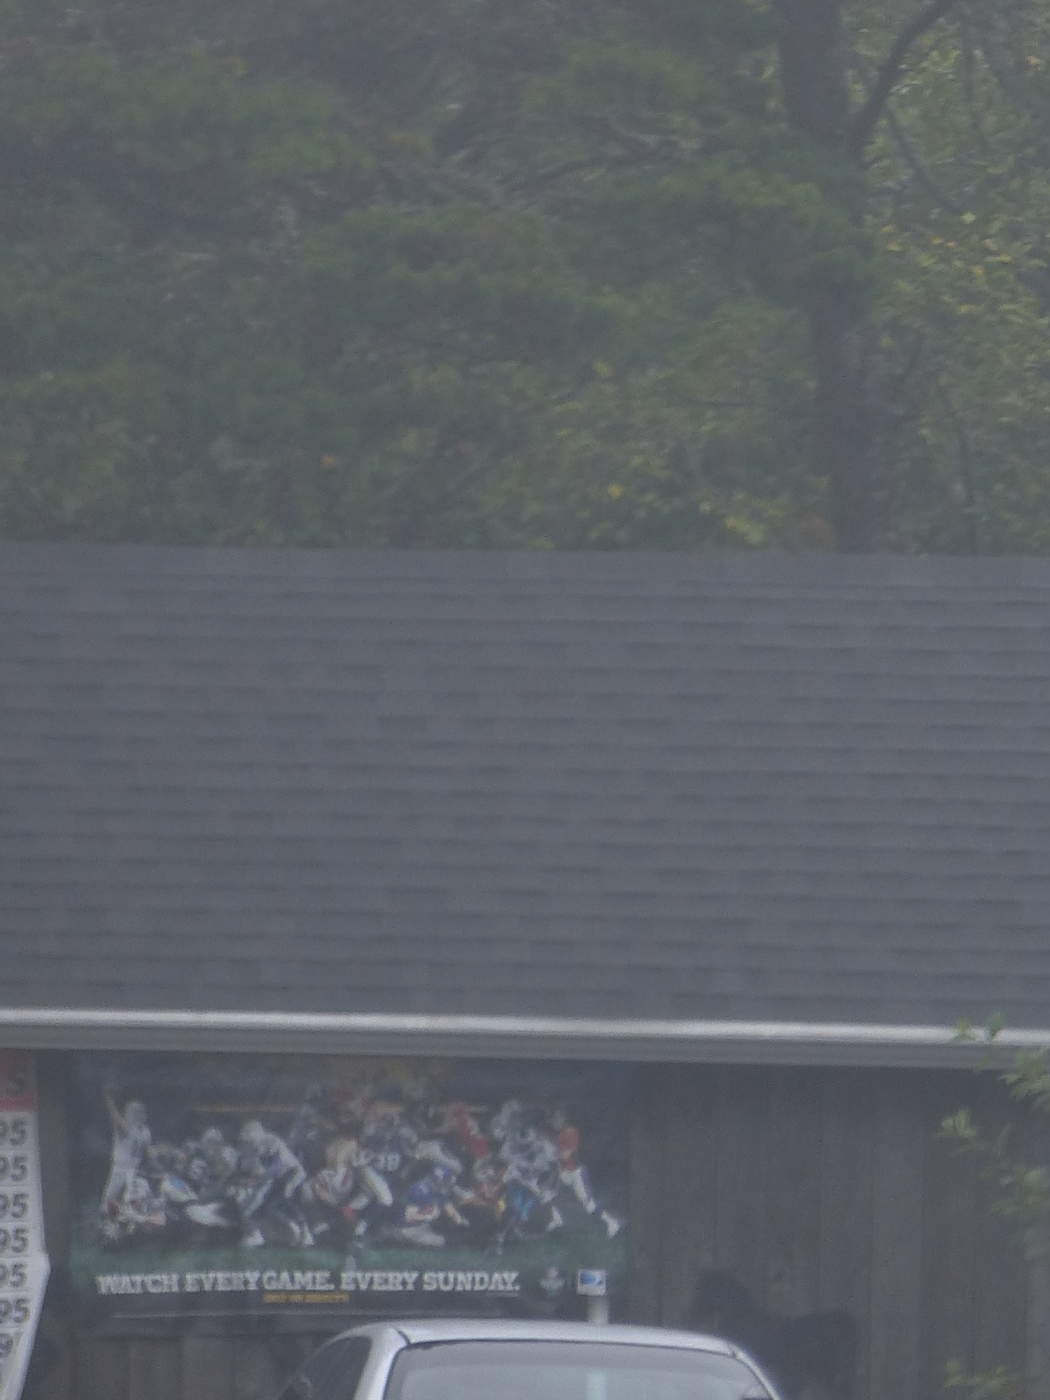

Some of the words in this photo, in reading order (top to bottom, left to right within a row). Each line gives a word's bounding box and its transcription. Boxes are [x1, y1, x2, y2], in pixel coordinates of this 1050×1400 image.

[96, 1273, 179, 1294] WATCH
[185, 1271, 260, 1292] EVERY
[262, 1270, 335, 1290] GAME.
[340, 1270, 418, 1291] EVERY
[422, 1270, 520, 1291] SUNDAY.
